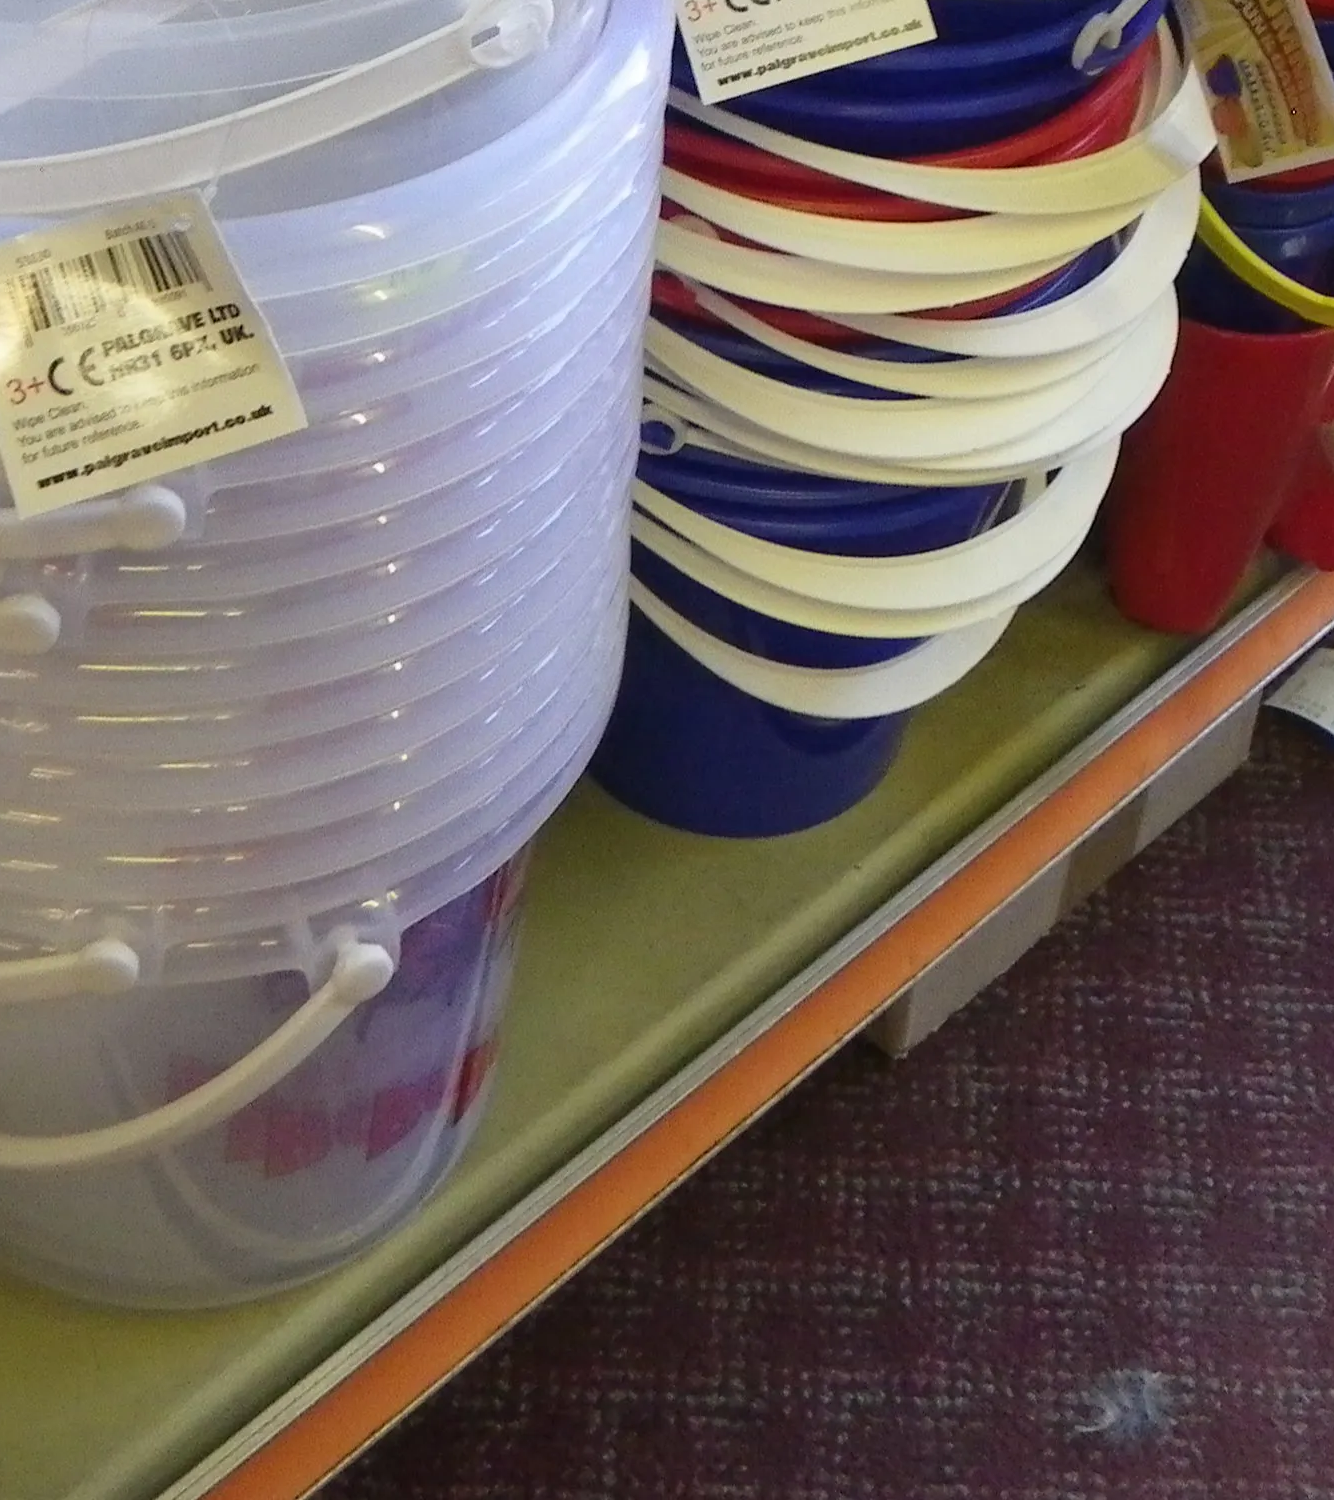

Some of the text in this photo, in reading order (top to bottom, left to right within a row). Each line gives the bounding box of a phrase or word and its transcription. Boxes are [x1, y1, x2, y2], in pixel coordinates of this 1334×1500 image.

[691, 30, 721, 45] Wipe
[721, 39, 738, 51] are
[741, 24, 782, 45] advised
[785, 21, 795, 32] to
[701, 60, 716, 72] for
[719, 50, 748, 67] future
[717, 18, 924, 87] www.palgraveimport.co.uk
[208, 303, 240, 325] LTD
[219, 324, 255, 346] UK.
[5, 376, 45, 405] 3+
[12, 414, 45, 431] Wipe
[17, 433, 42, 448] You
[45, 426, 66, 440] are
[69, 408, 118, 433] advised
[21, 452, 39, 466] for
[41, 440, 80, 460] future
[37, 403, 274, 490] www.palgraveimport.co.uk
